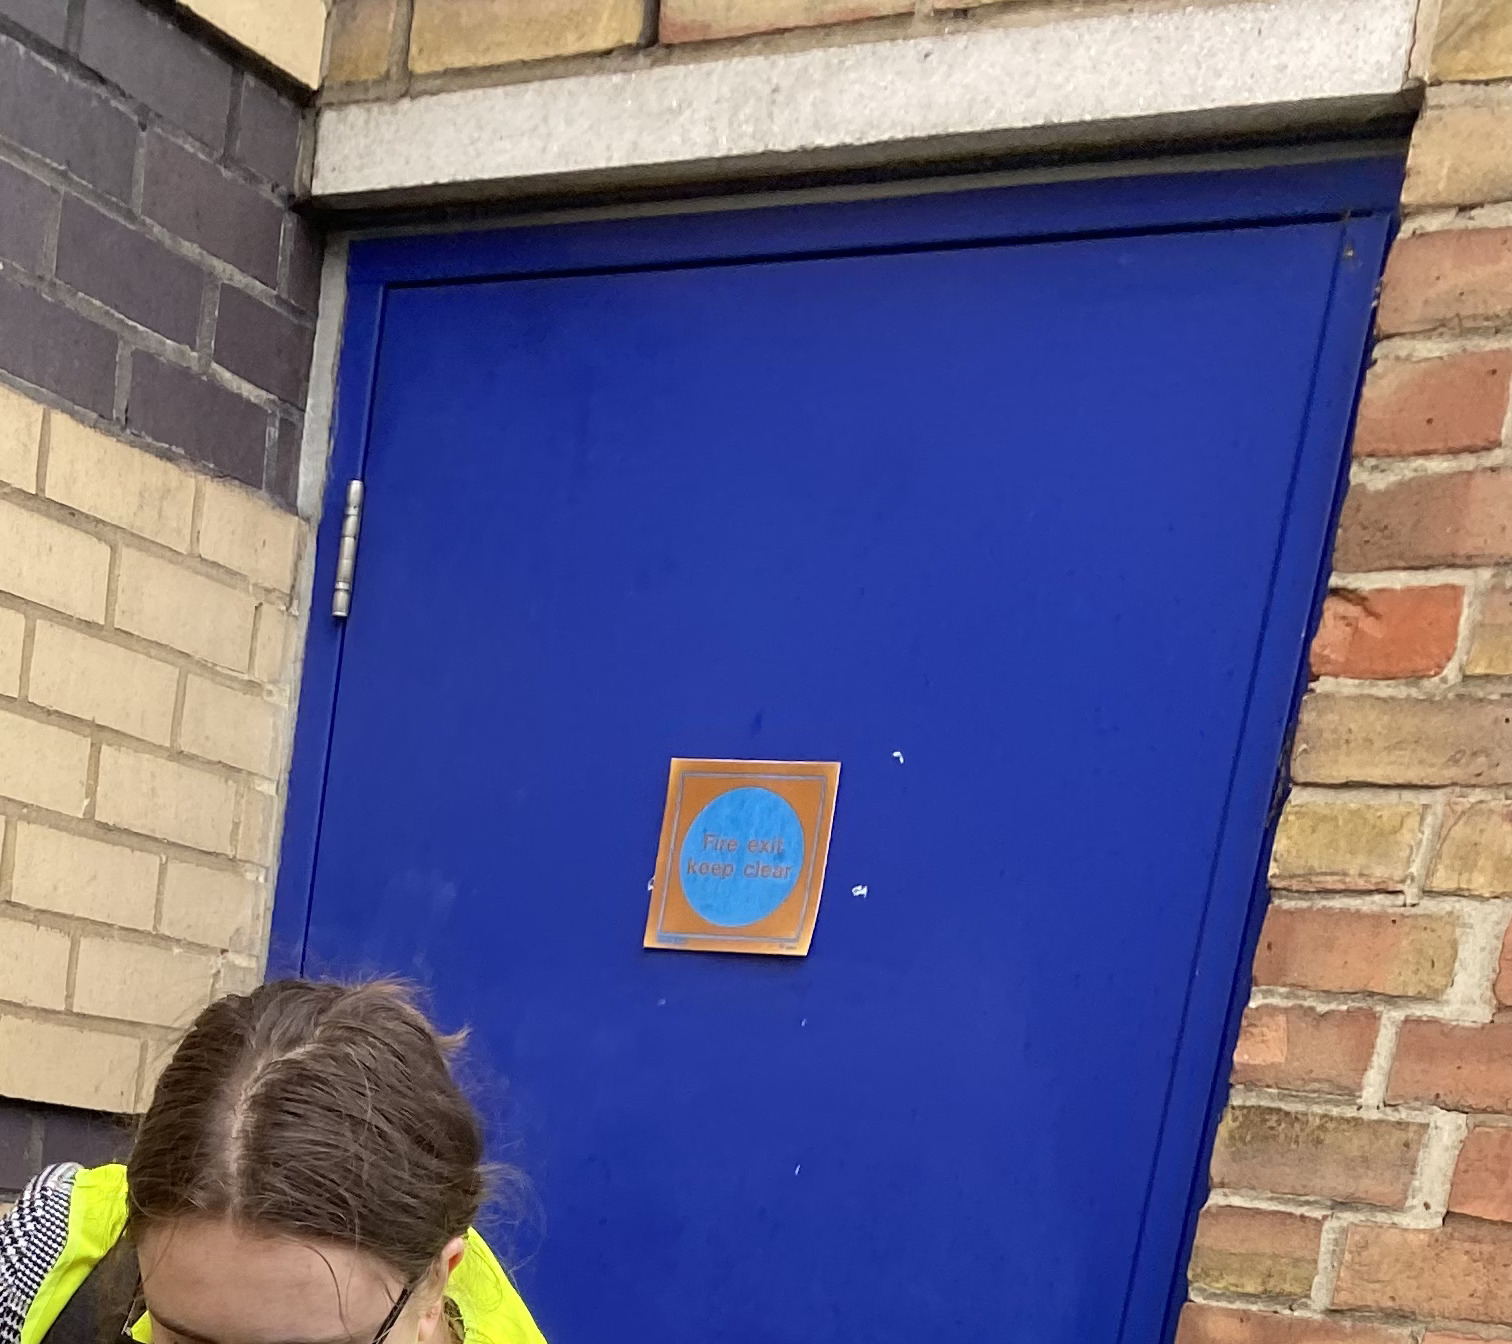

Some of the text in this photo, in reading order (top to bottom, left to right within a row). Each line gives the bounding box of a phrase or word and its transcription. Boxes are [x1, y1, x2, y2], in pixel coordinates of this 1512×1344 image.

[703, 833, 784, 854] Fire exit
[687, 857, 791, 879] keep clear
